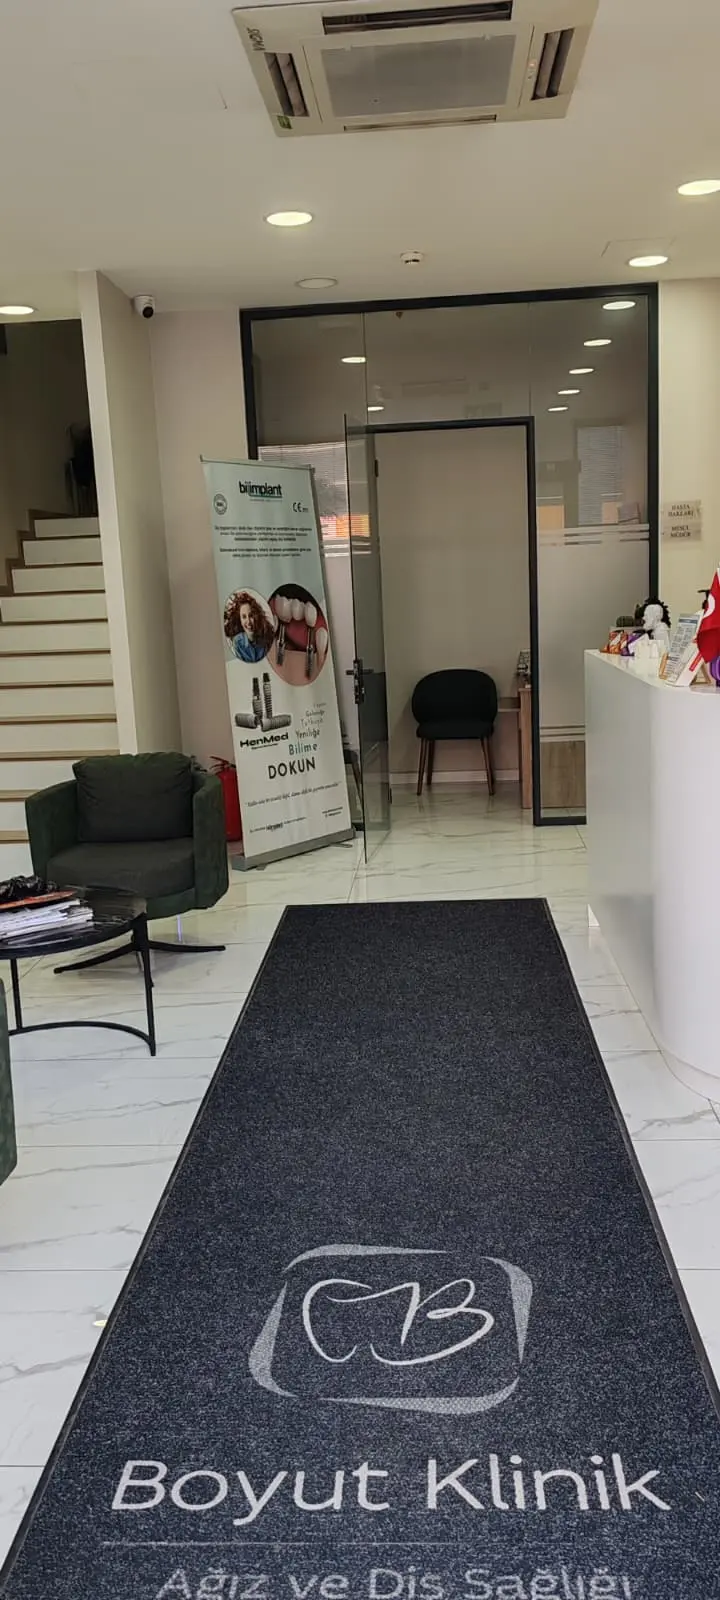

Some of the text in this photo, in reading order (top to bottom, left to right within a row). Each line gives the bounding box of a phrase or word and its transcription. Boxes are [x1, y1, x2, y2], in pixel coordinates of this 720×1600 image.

[240, 732, 289, 748] HenMed
[288, 743, 318, 756] Bilime
[268, 757, 316, 779] DOKUN
[110, 1453, 671, 1526] Boyut Klinik
[288, 1574, 350, 1600] ve
